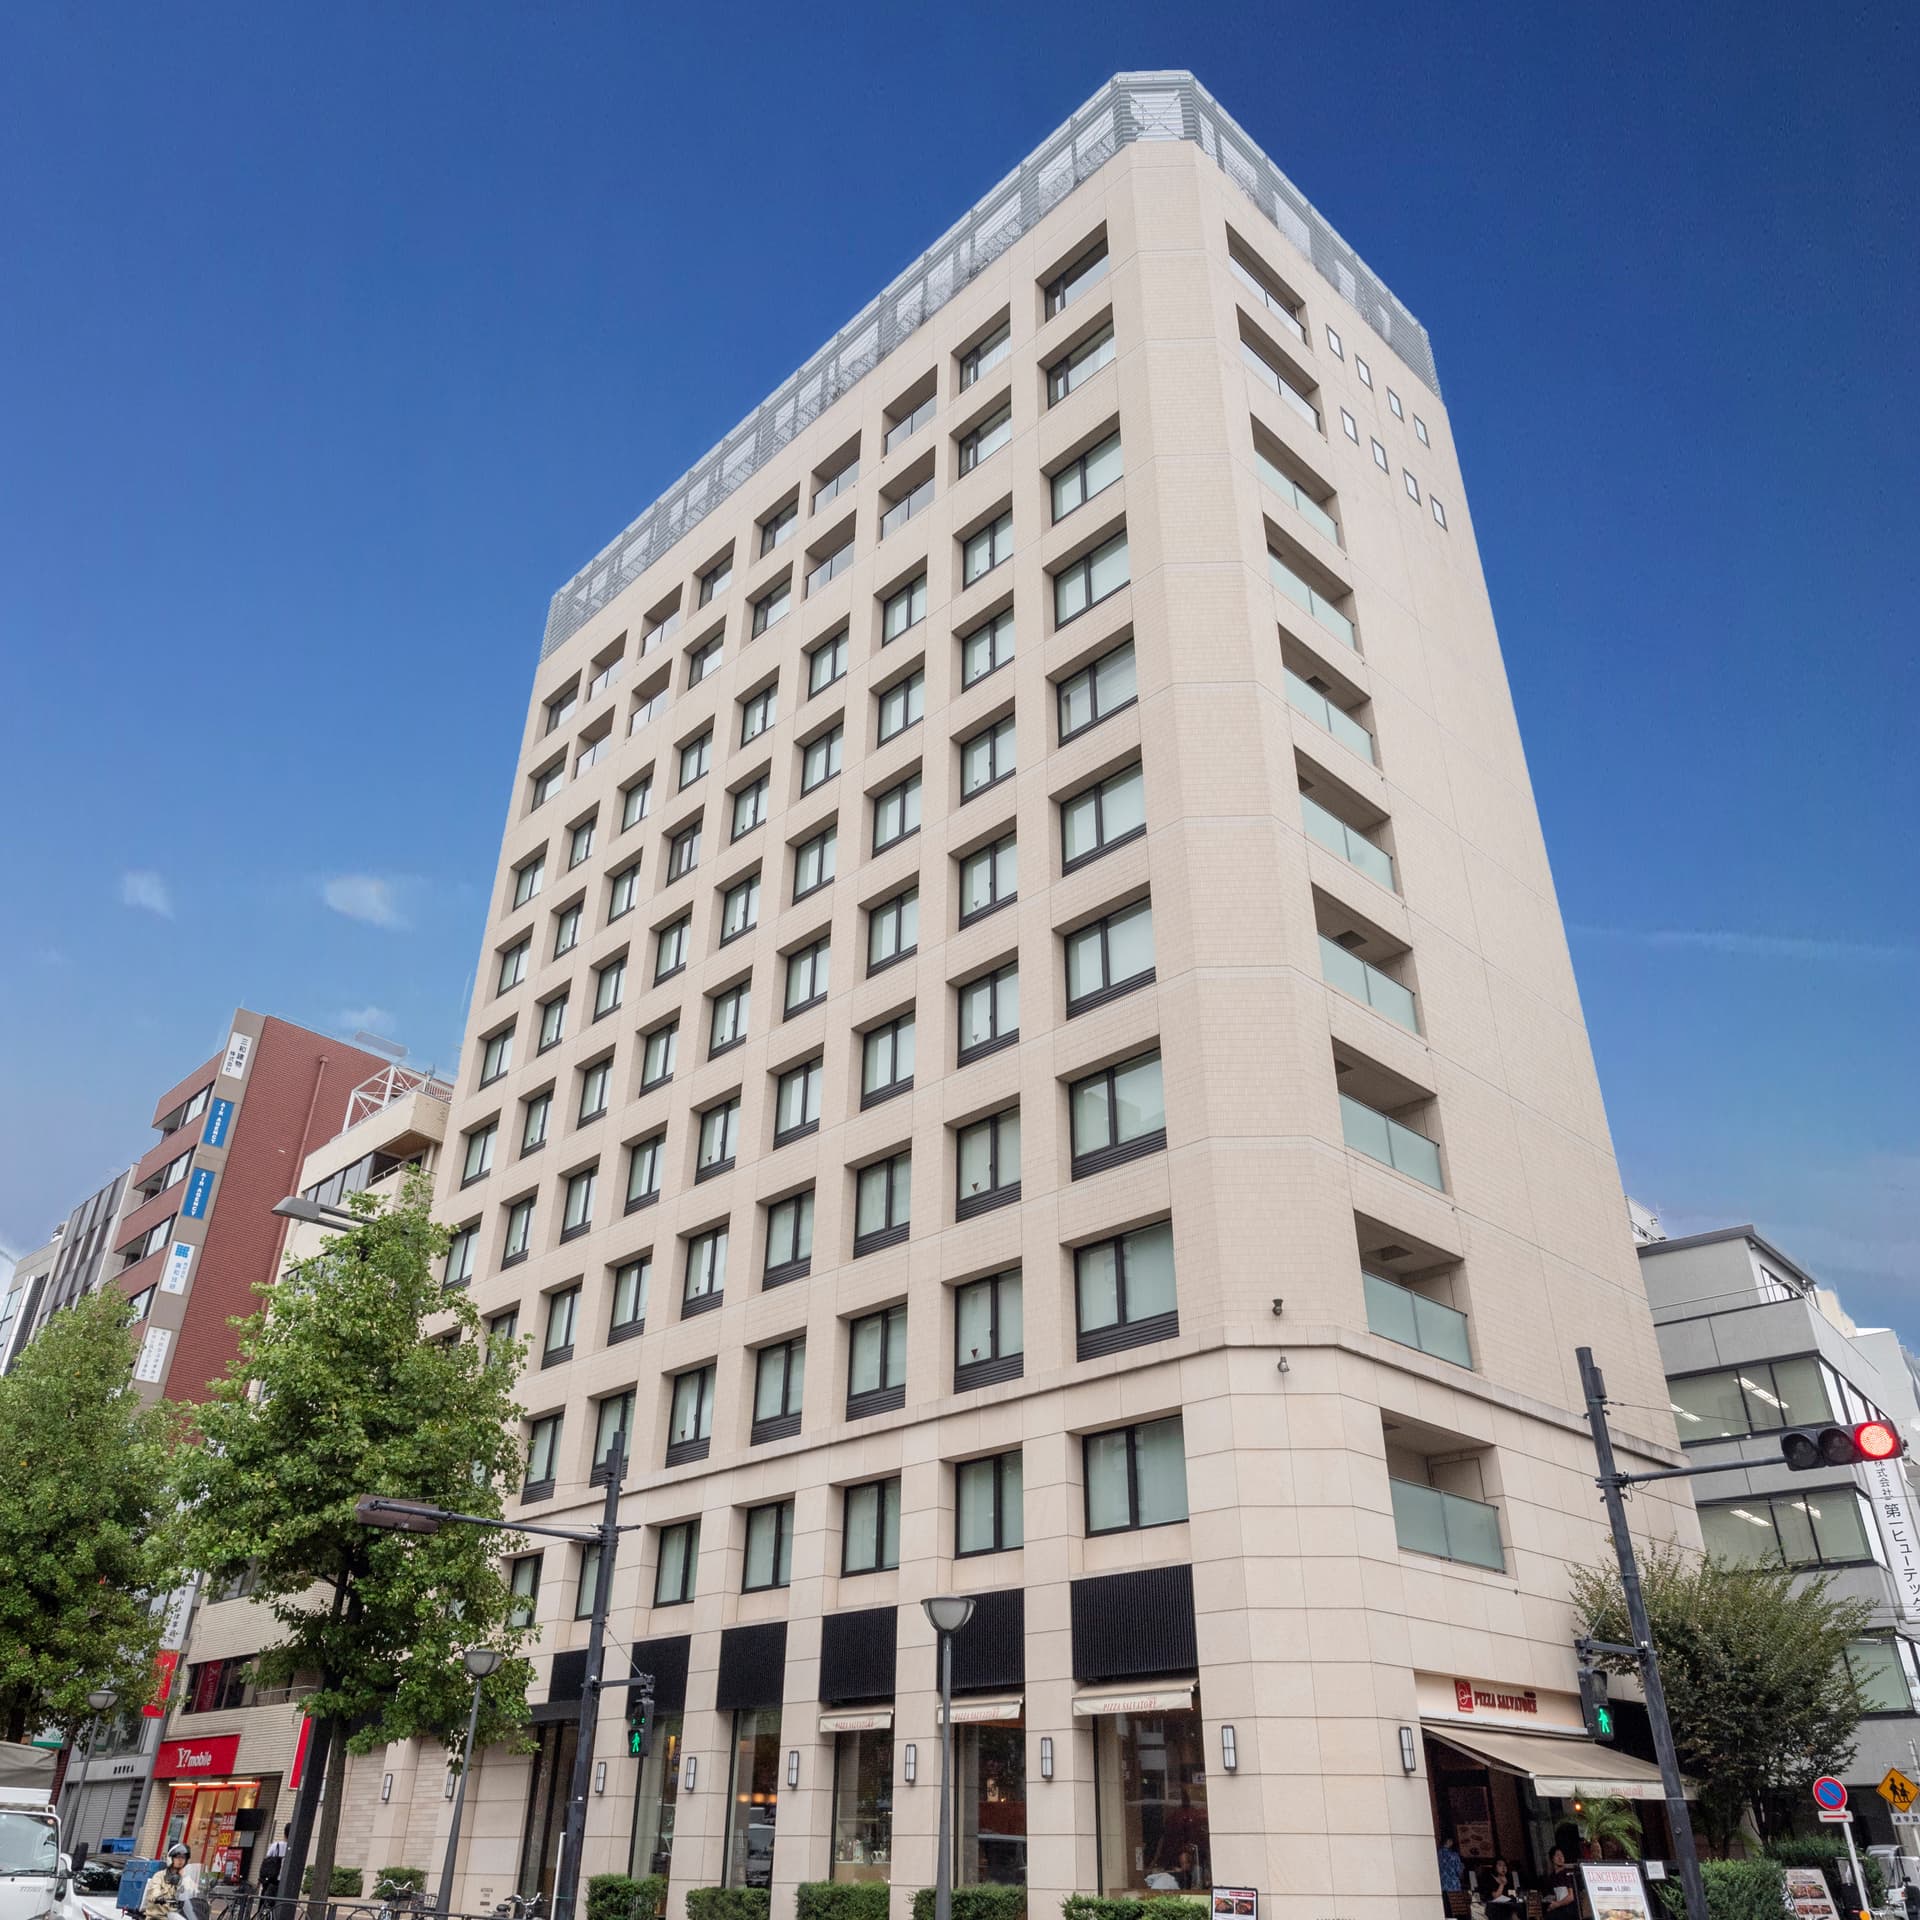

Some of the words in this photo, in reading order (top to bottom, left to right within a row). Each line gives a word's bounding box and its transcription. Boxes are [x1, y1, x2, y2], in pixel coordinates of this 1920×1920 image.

[1103, 1702, 1120, 1712] PIZZA
[1474, 1691, 1496, 1708] PIZZA
[1497, 1694, 1537, 1713] SALVATORE
